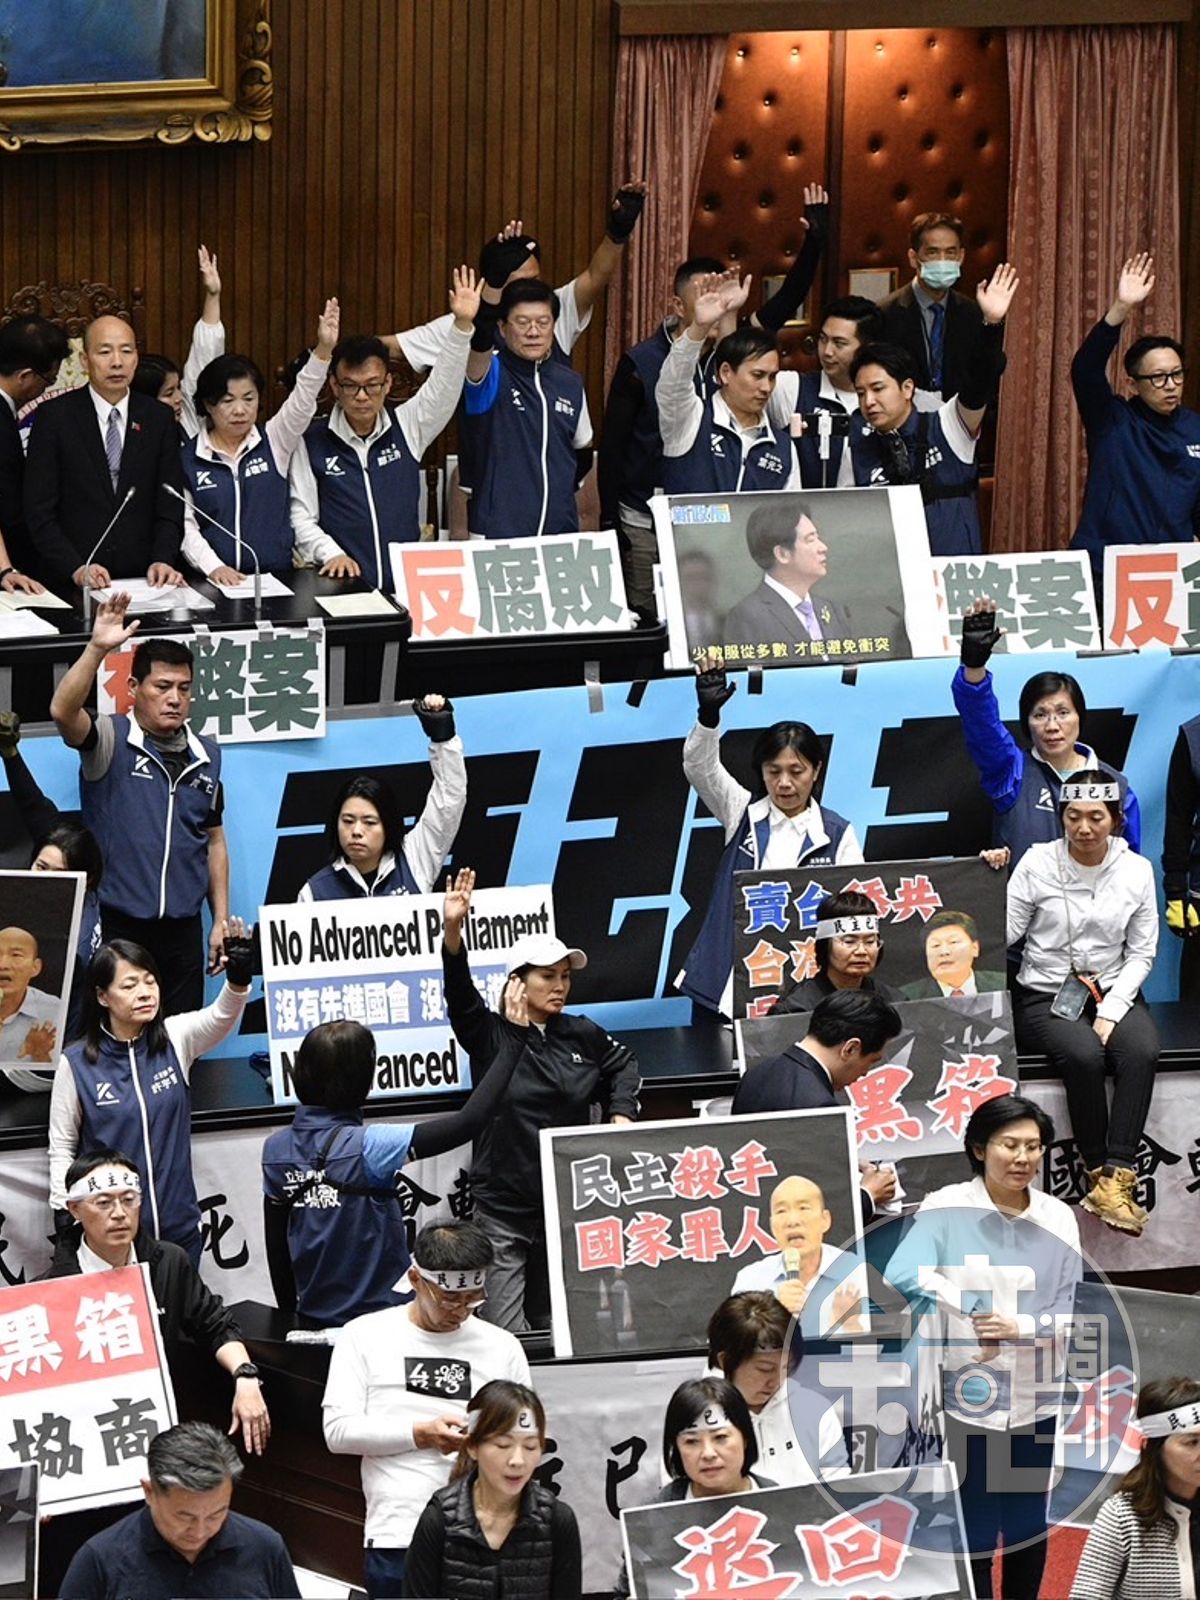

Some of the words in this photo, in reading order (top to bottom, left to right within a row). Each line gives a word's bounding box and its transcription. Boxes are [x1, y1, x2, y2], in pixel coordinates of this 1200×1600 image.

[402, 539, 623, 637] 反腐敗
[933, 558, 1094, 652] 弊案
[1108, 552, 1200, 649] 反
[692, 641, 788, 662] 少數服從多數
[794, 637, 891, 657] 才能避免衝突
[269, 919, 302, 967] No
[309, 909, 422, 964] Advanced
[425, 902, 550, 955] Pliament
[833, 916, 880, 934] 民主已
[274, 979, 410, 1034] 沒有先進國會
[371, 1038, 458, 1090] anced
[570, 1139, 779, 1210] 民主殺手
[574, 1206, 782, 1272] 國家罪人
[673, 1493, 919, 1600] 退回
